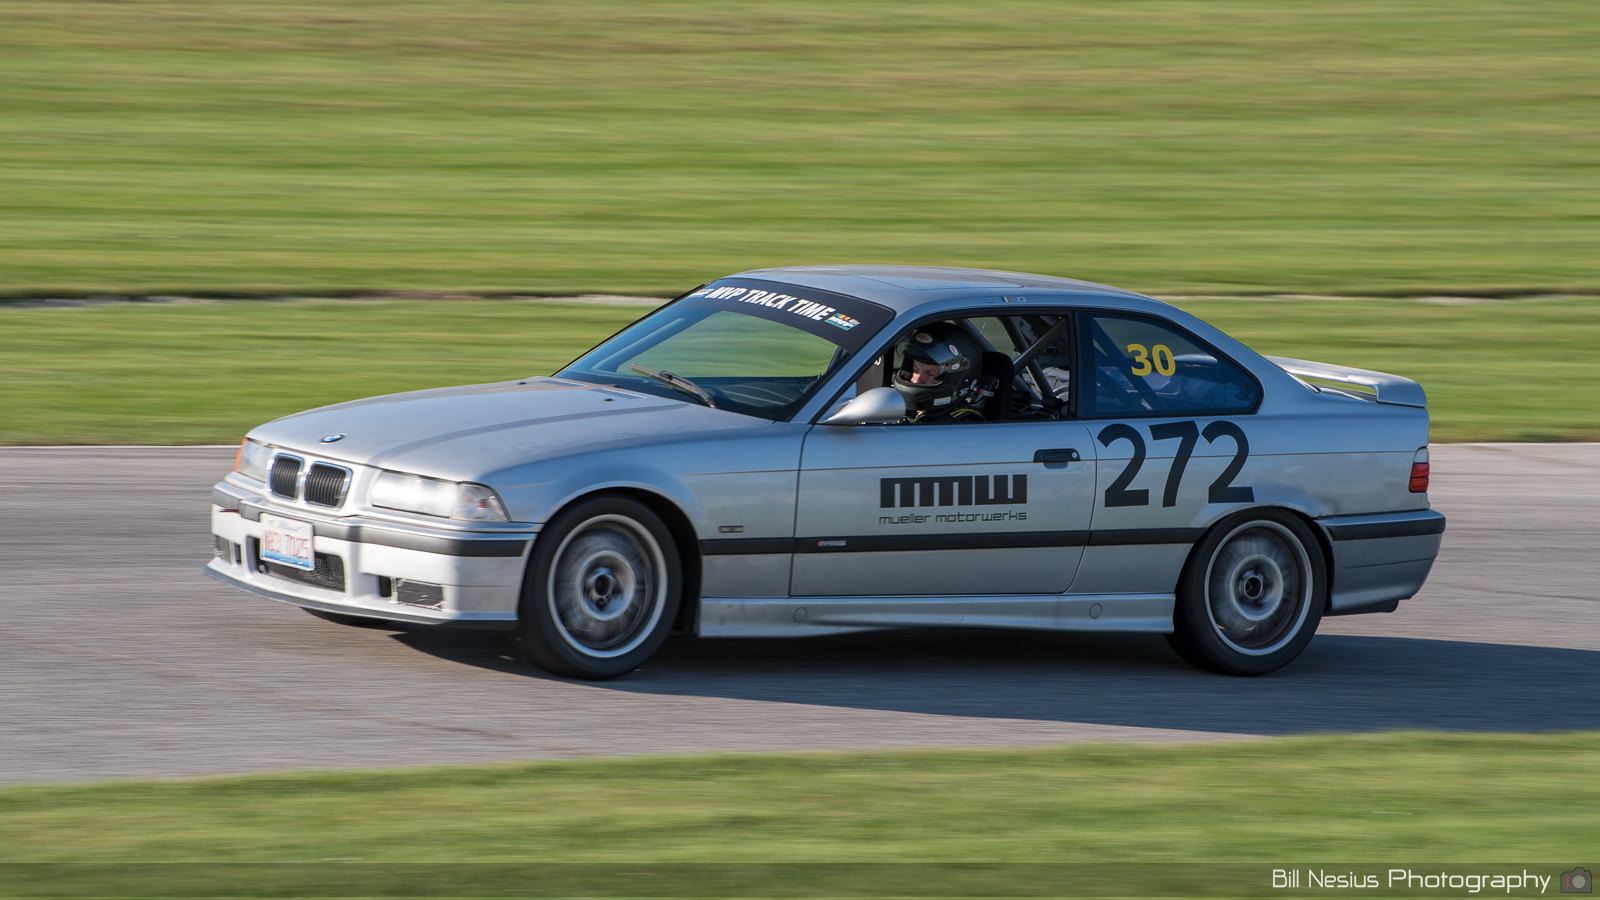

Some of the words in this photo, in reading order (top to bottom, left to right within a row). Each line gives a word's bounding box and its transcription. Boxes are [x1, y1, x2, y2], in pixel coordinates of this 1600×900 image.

[704, 286, 748, 300] MVP
[738, 289, 798, 310] TRACK
[786, 298, 837, 322] TIME
[1126, 343, 1176, 377] 30
[1096, 420, 1256, 508] 272
[878, 512, 931, 525] mueller
[935, 510, 1028, 523] motorwerks
